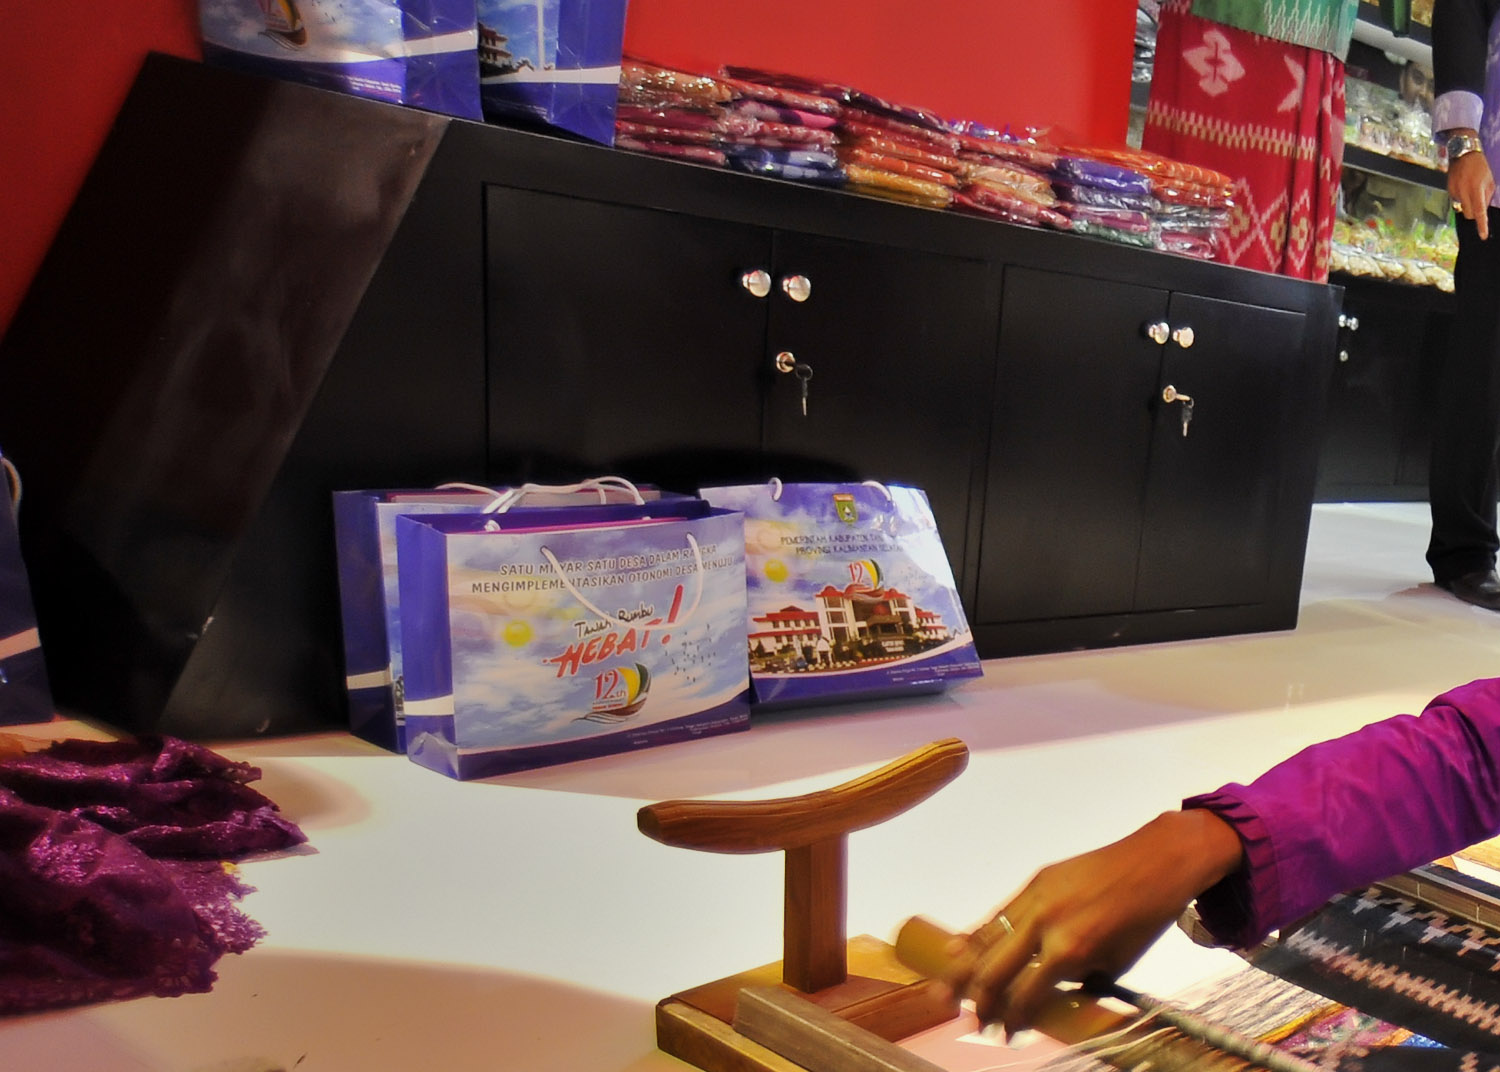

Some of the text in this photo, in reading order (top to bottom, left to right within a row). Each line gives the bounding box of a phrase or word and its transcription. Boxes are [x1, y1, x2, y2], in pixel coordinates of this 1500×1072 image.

[500, 564, 533, 576] SATU
[587, 560, 616, 572] SATU
[620, 556, 646, 569] DESA
[649, 551, 679, 565] DALAM
[683, 544, 717, 559] RAGKA
[628, 568, 673, 583] OTONOMI
[675, 564, 698, 576] DESA
